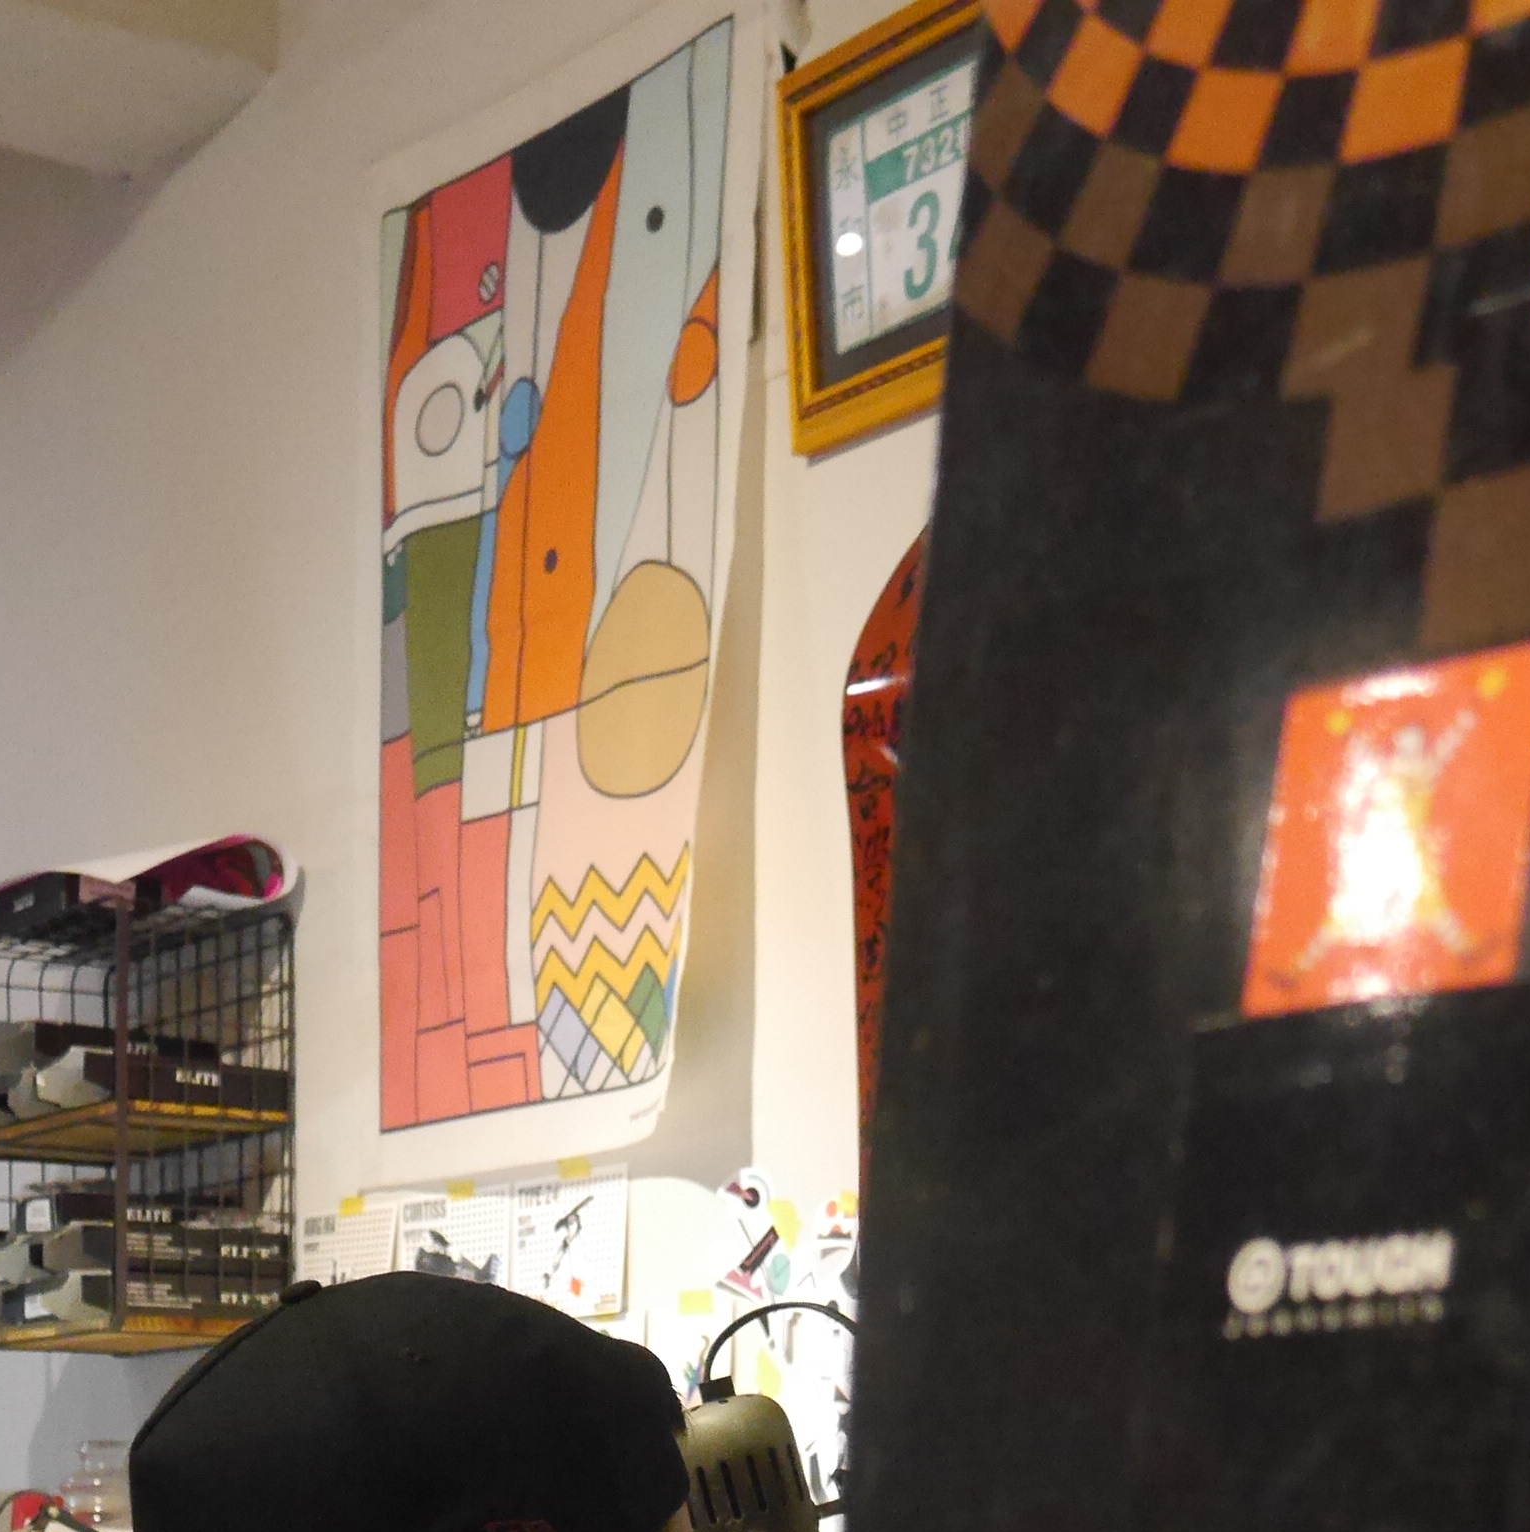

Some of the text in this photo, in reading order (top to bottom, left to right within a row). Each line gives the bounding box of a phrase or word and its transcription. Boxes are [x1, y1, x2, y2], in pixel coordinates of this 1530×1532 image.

[835, 147, 867, 325] 永市
[175, 1067, 221, 1087] ELITE
[126, 1208, 172, 1223] ELITE
